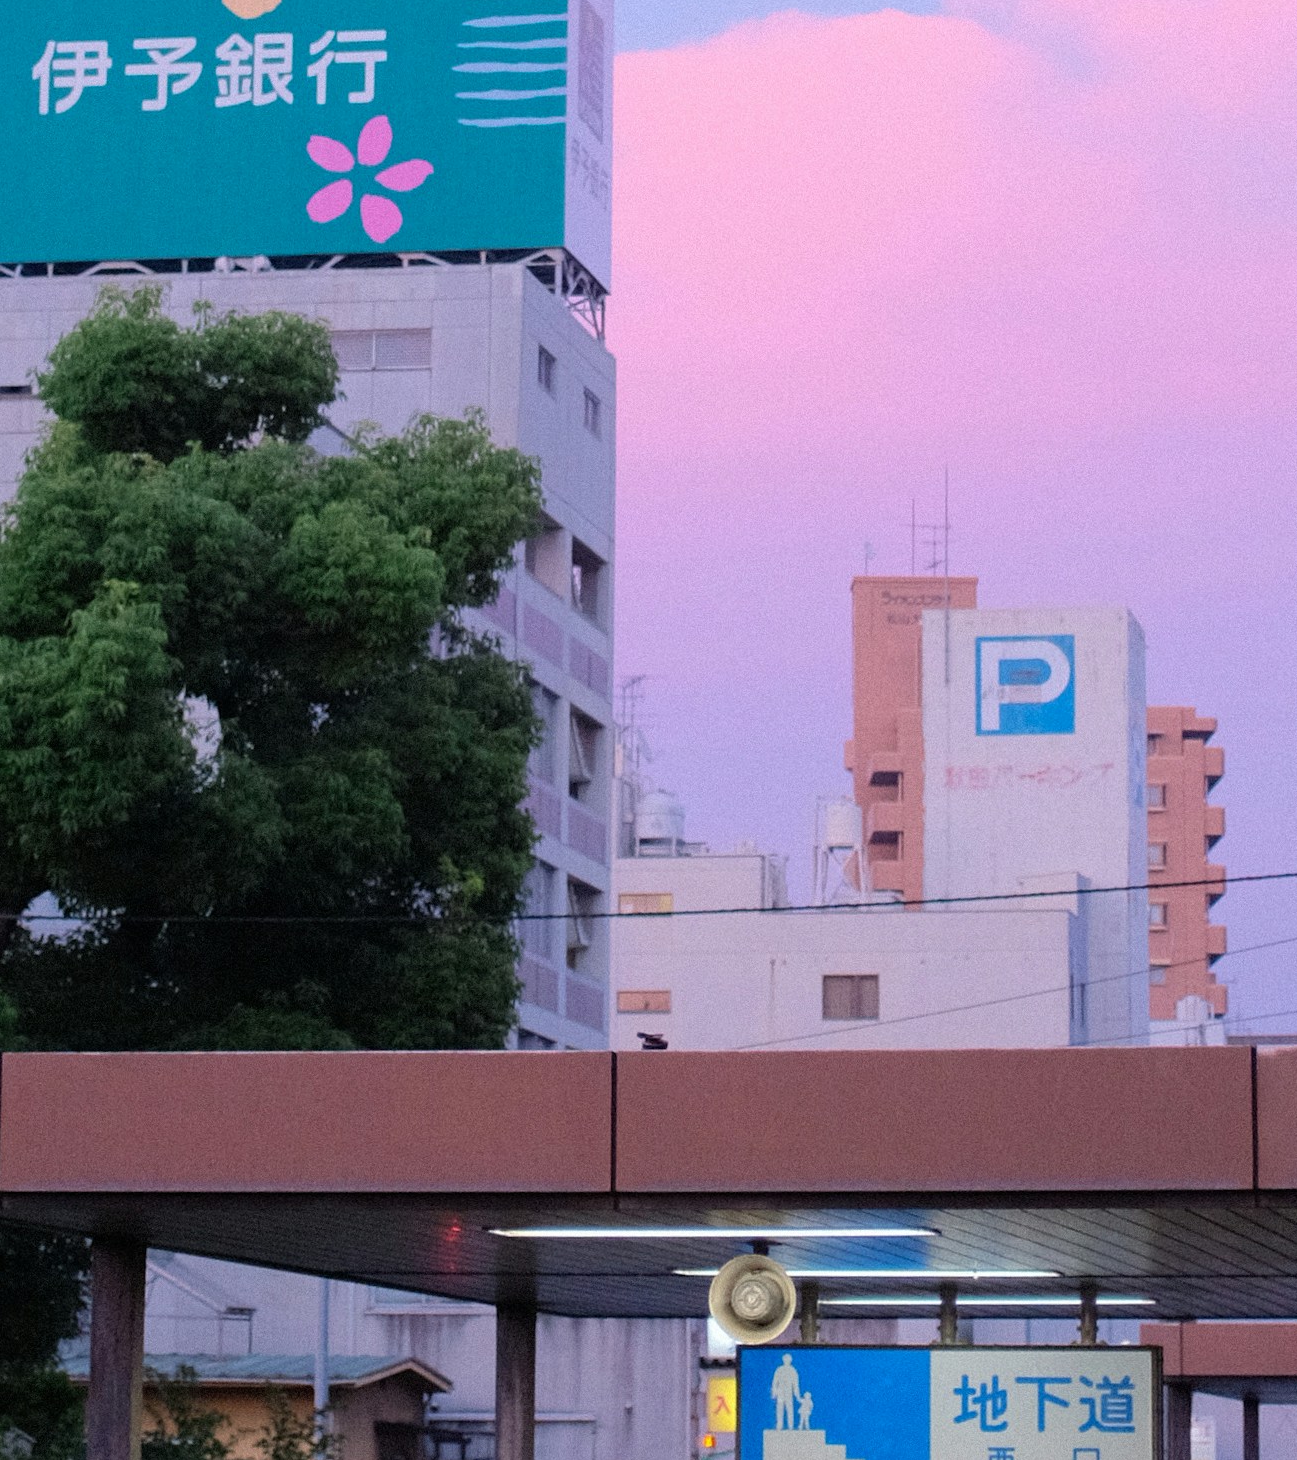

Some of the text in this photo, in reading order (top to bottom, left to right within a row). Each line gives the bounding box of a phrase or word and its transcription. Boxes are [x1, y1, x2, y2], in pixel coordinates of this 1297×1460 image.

[32, 29, 388, 115] 伊予銀行
[980, 641, 1070, 731] P
[953, 1374, 1136, 1433] 地下道
